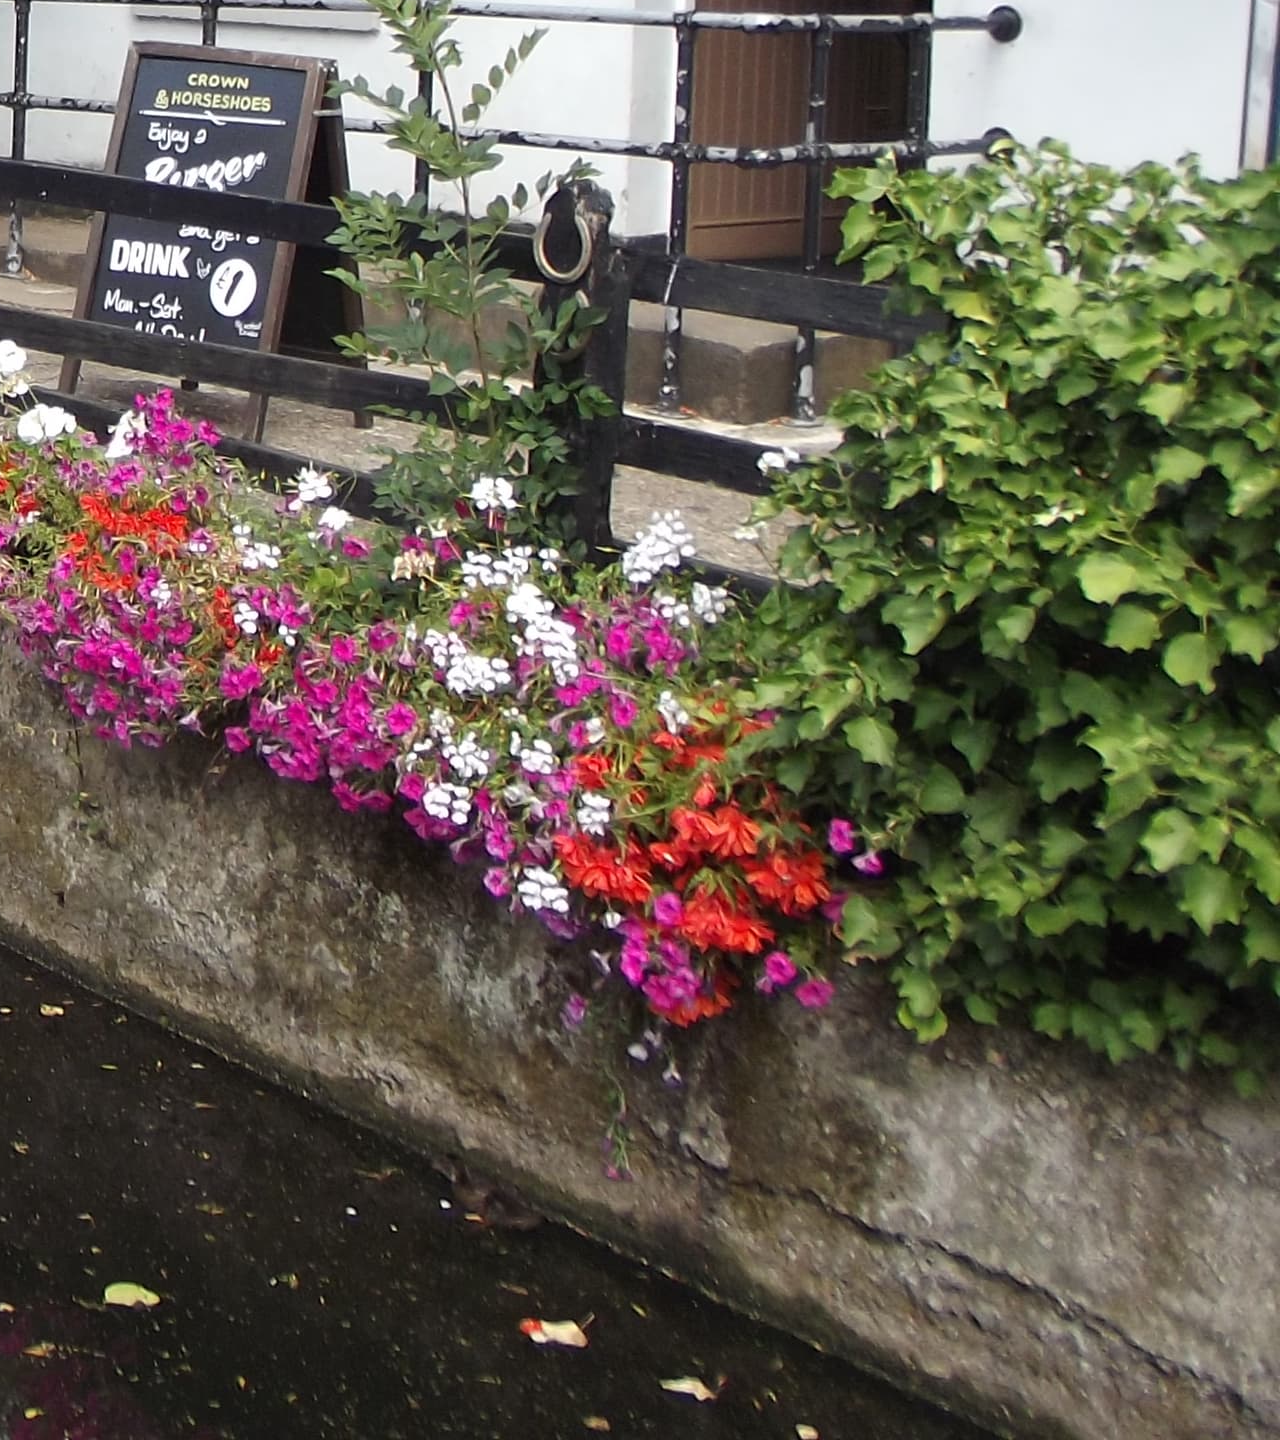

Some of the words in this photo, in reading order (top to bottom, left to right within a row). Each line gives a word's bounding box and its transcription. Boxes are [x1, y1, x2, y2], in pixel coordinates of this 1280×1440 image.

[187, 73, 249, 90] CROWN
[154, 89, 169, 110] &
[171, 91, 272, 113] HORSESHOES
[148, 122, 190, 153] Enjoy
[194, 129, 207, 144] a
[109, 239, 191, 279] DRINK
